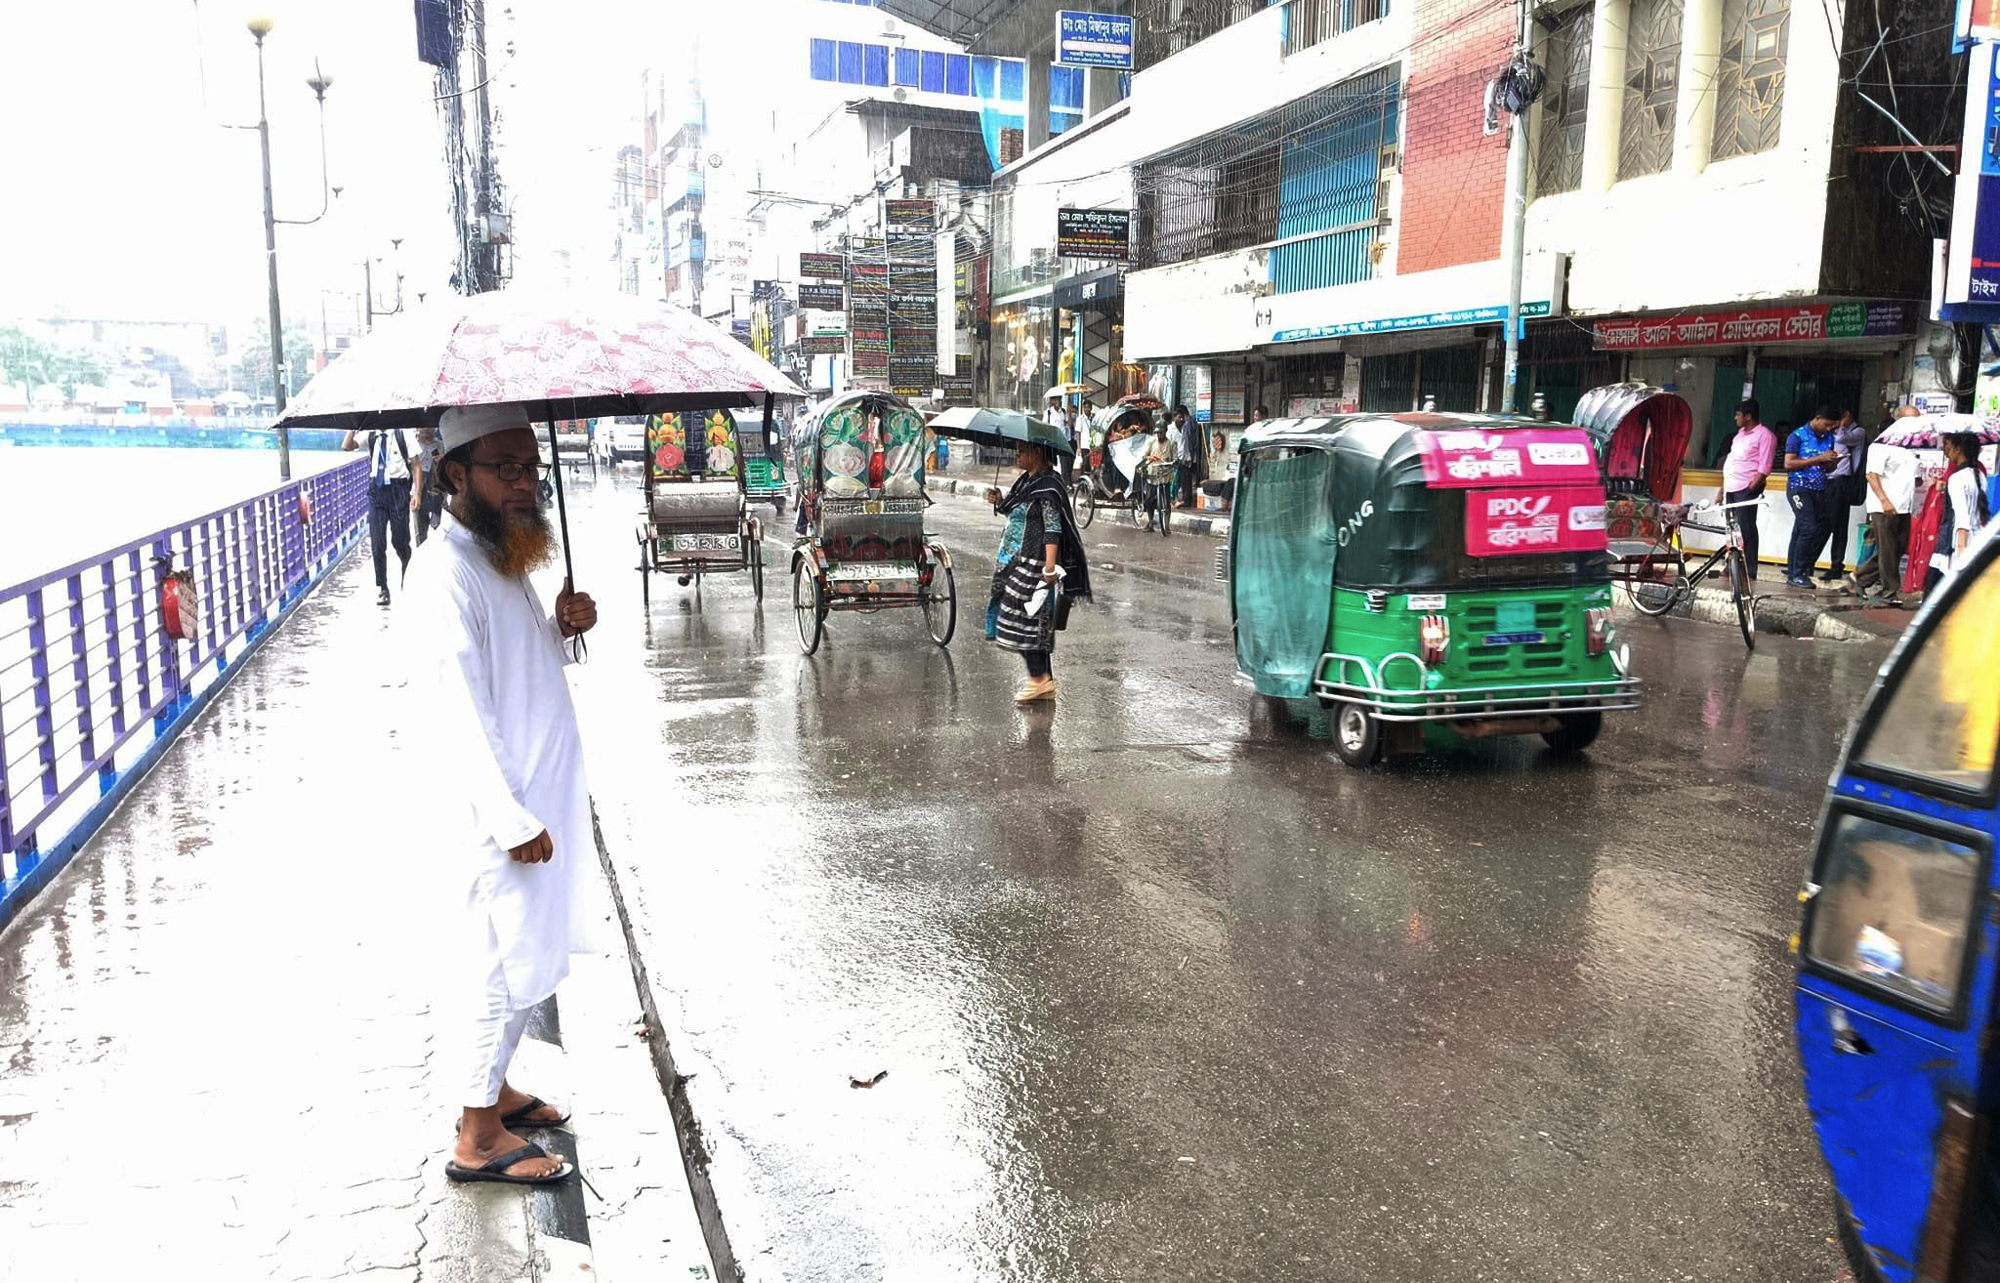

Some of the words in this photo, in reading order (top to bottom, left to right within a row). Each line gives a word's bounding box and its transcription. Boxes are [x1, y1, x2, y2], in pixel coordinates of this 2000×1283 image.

[1085, 211, 1107, 224] শফিকুল
[1108, 213, 1128, 223] ইসলাম
[1971, 278, 1998, 297] টাইম
[1605, 320, 1641, 346] মেসার্স
[1643, 315, 1719, 344] আল-আমিন
[1722, 312, 1782, 339] মেডিকেল
[1487, 496, 1534, 517] IPDC
